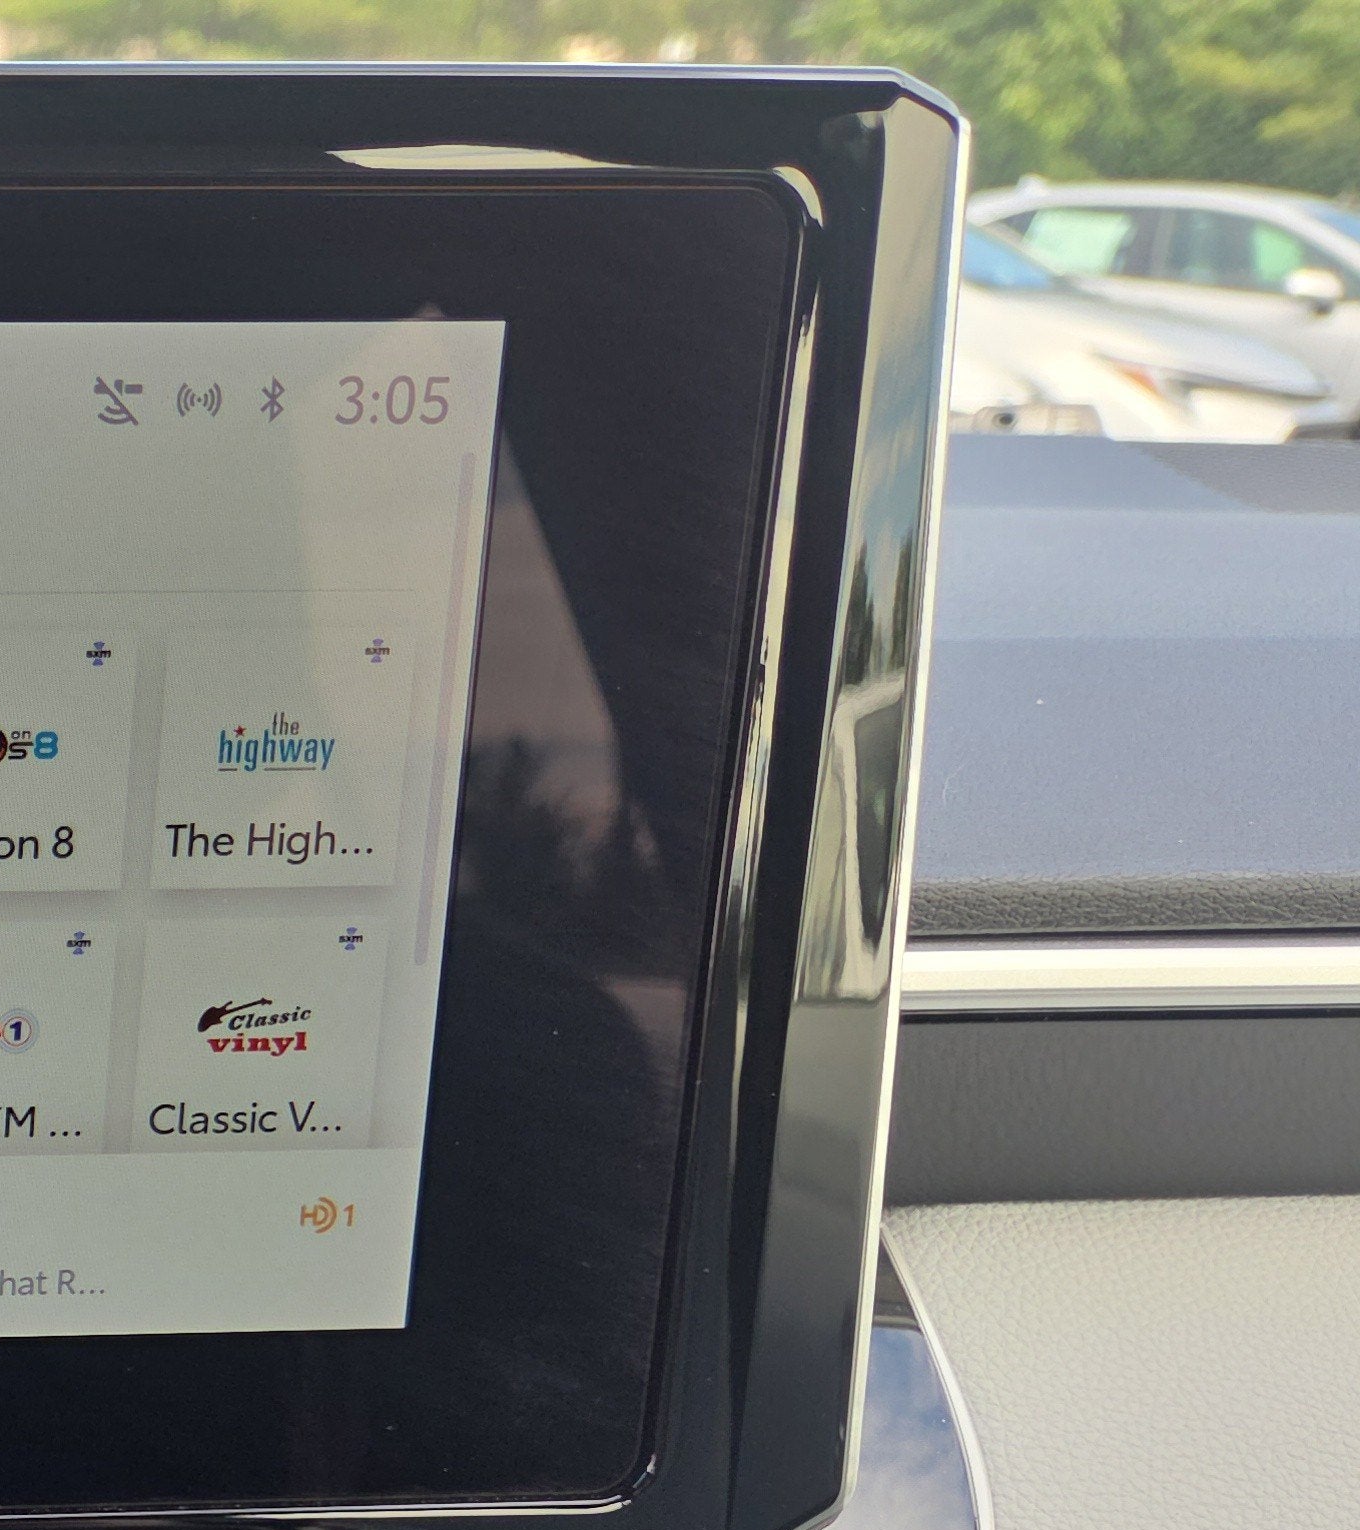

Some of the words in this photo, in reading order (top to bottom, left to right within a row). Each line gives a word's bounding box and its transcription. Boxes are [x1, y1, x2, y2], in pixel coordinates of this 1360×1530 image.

[335, 375, 451, 427] 3:05
[272, 711, 300, 736] the
[33, 731, 59, 760] 8
[217, 727, 336, 772] highway
[51, 825, 75, 859] 8
[165, 822, 235, 858] The
[9, 1020, 23, 1042] 1
[227, 1006, 313, 1031] Classic
[206, 1031, 308, 1057] vinyl
[148, 1101, 278, 1136] Classic
